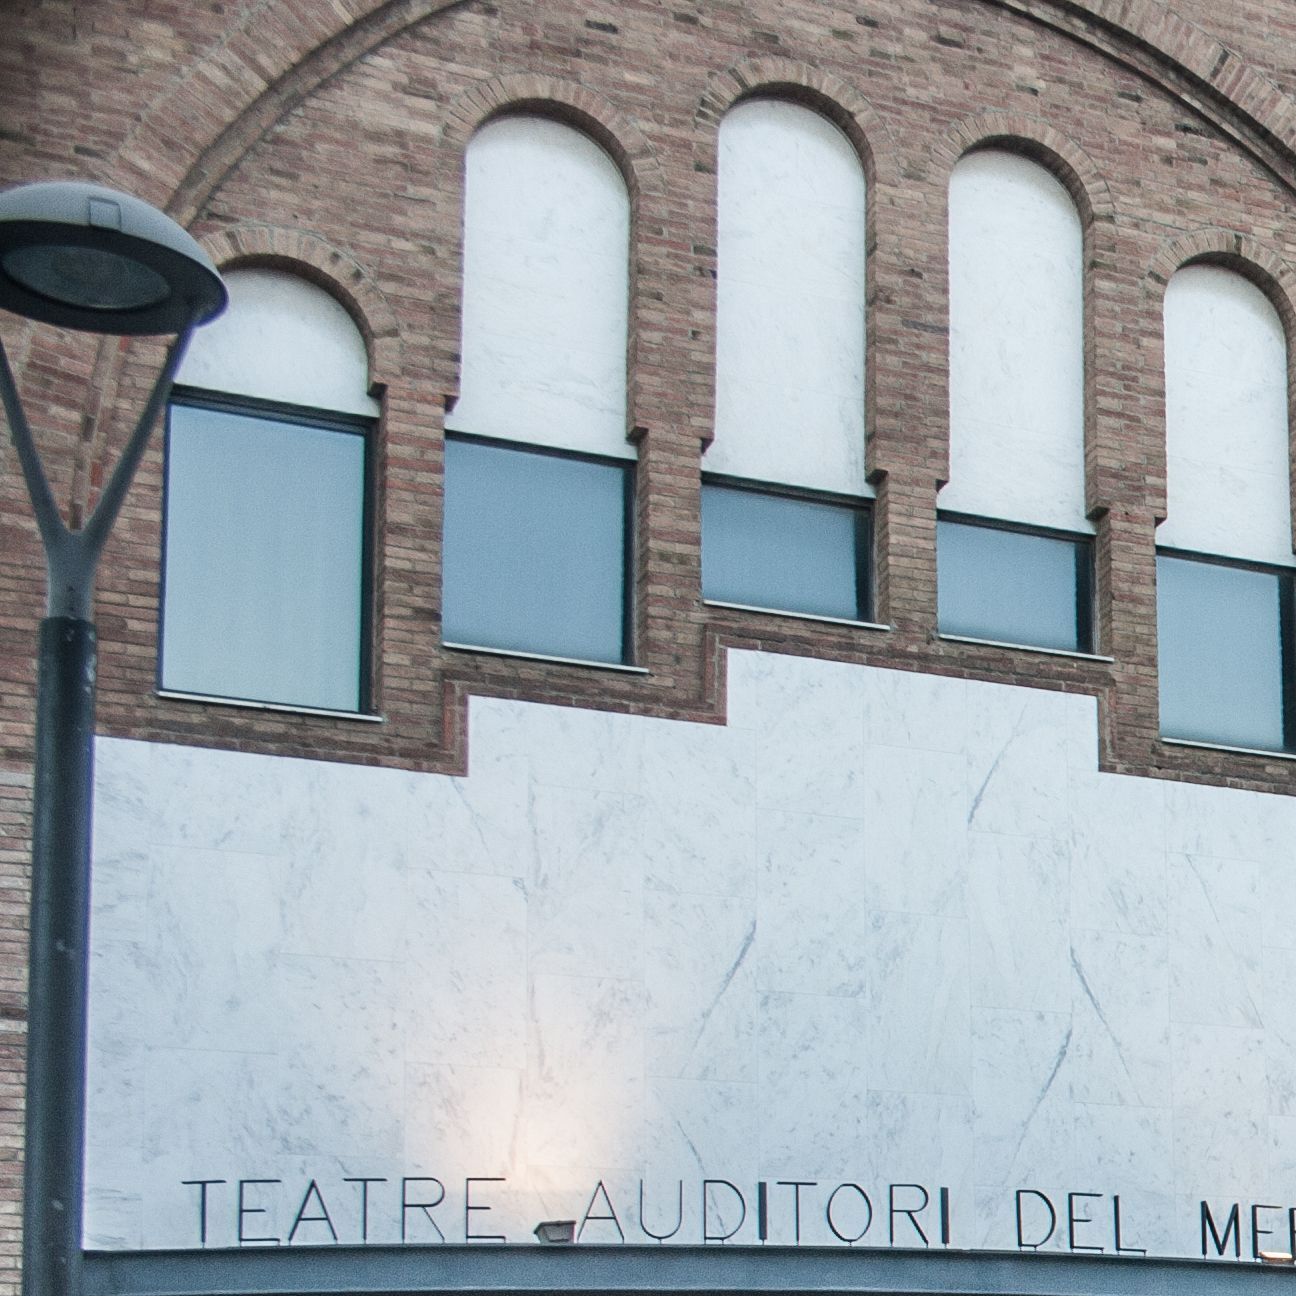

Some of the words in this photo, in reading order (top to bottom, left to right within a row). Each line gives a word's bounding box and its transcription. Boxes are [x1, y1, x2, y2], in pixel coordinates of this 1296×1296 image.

[181, 1176, 507, 1245] TEATRE
[576, 1178, 951, 1246] AUDITORI
[1015, 1188, 1148, 1254] DEL
